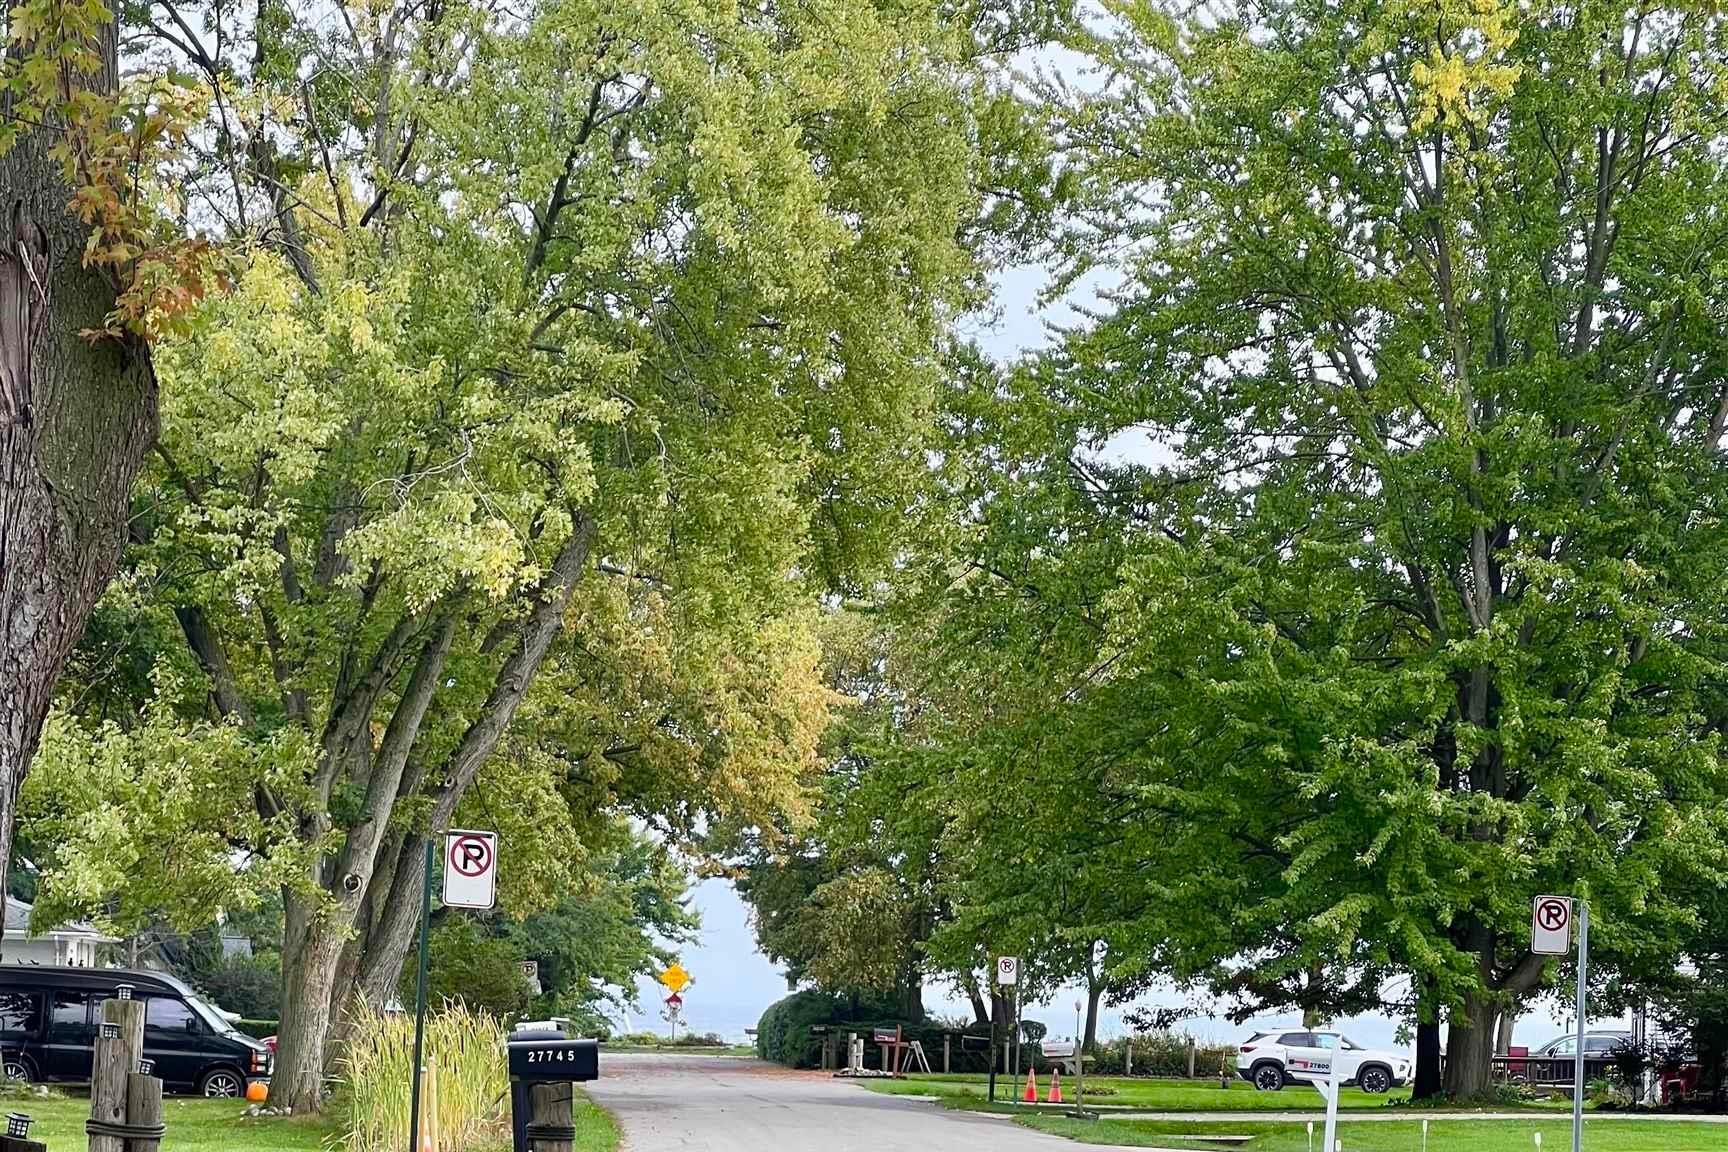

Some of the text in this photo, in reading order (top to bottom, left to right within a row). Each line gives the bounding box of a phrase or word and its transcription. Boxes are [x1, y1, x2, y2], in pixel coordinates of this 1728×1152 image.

[463, 844, 484, 869] P
[1546, 904, 1562, 925] P
[528, 1050, 575, 1062] 27745
